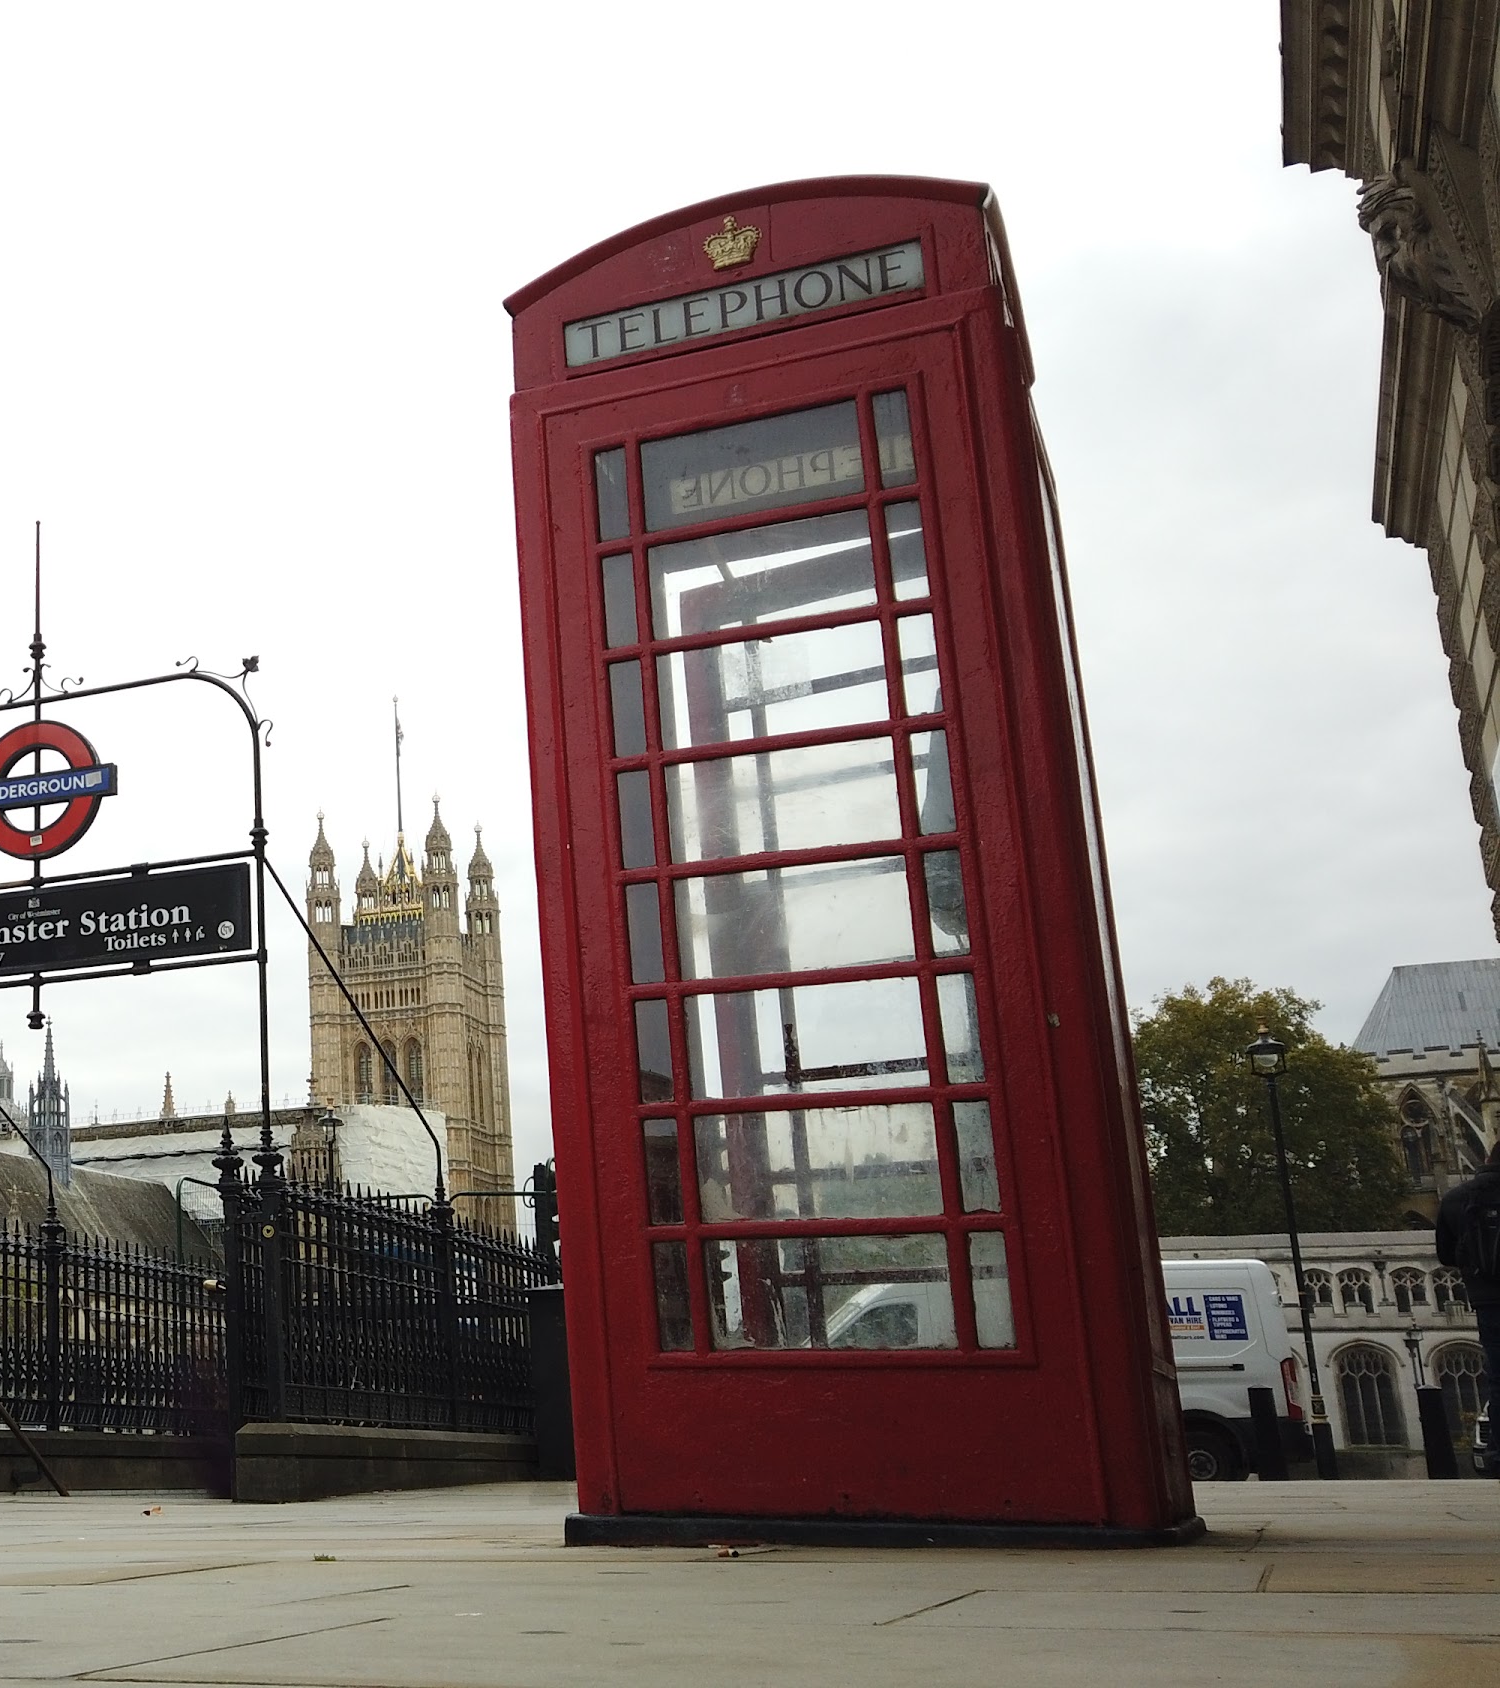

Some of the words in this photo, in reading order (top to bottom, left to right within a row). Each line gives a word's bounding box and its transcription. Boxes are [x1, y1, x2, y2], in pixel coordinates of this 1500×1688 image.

[577, 250, 908, 359] TELEPHONE
[79, 903, 192, 936] Station
[104, 932, 167, 951] Toilets
